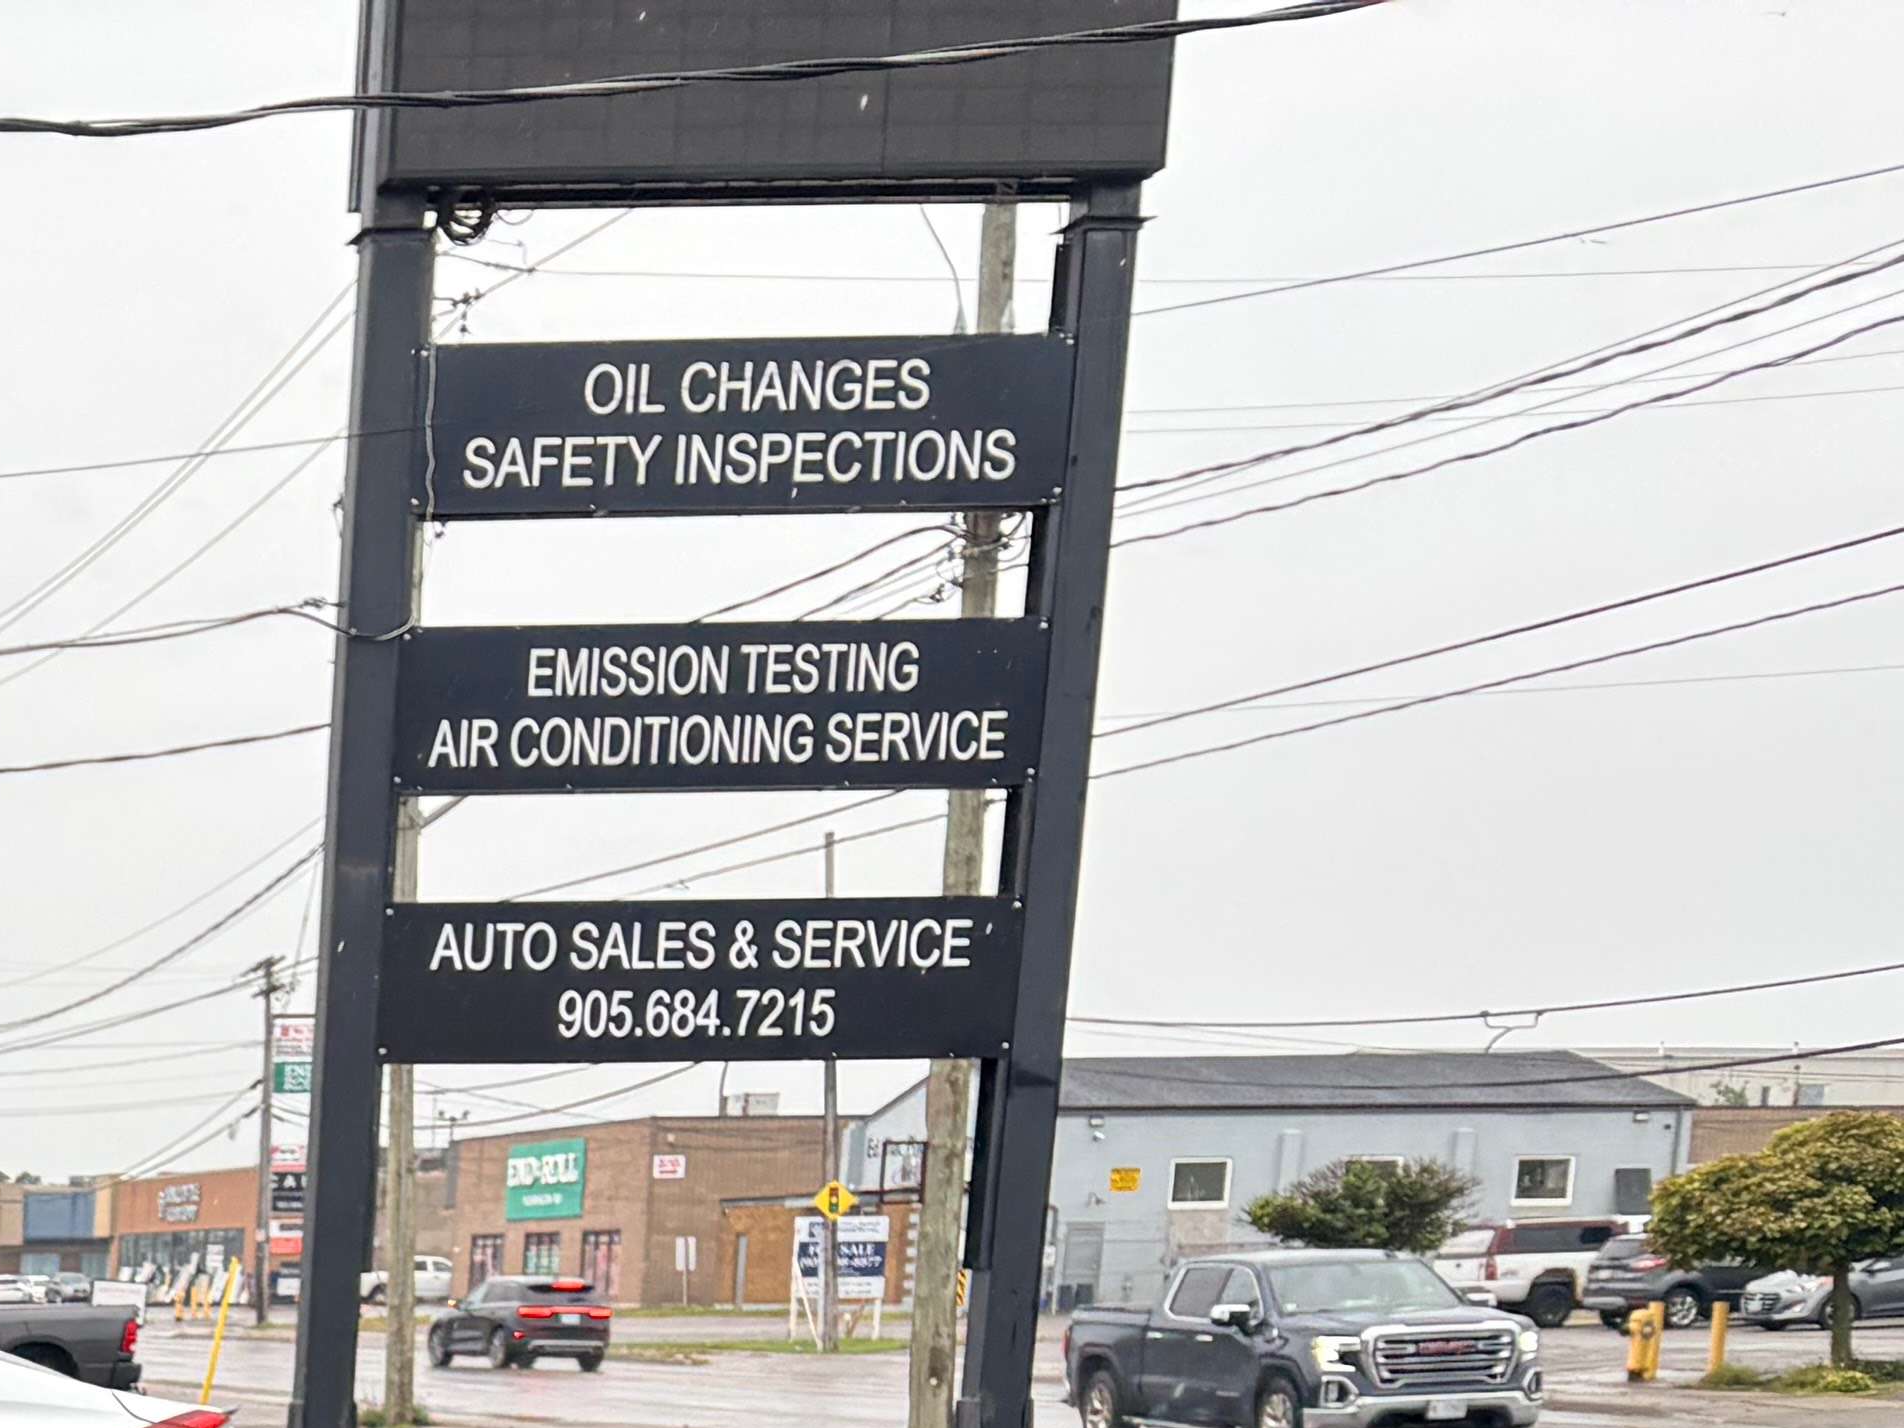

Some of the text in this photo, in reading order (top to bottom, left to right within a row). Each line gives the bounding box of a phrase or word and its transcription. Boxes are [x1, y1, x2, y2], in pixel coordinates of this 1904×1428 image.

[584, 358, 931, 415] OIL CHANGES
[462, 428, 1017, 489] SAFETY INSPECTIONS
[527, 641, 920, 697] EMISSION TESTING
[427, 710, 1009, 768] AIR CONDITIONING SERVICE
[429, 918, 974, 971] AUTO SALES & SERVICE
[557, 987, 836, 1039] 905.684.7215
